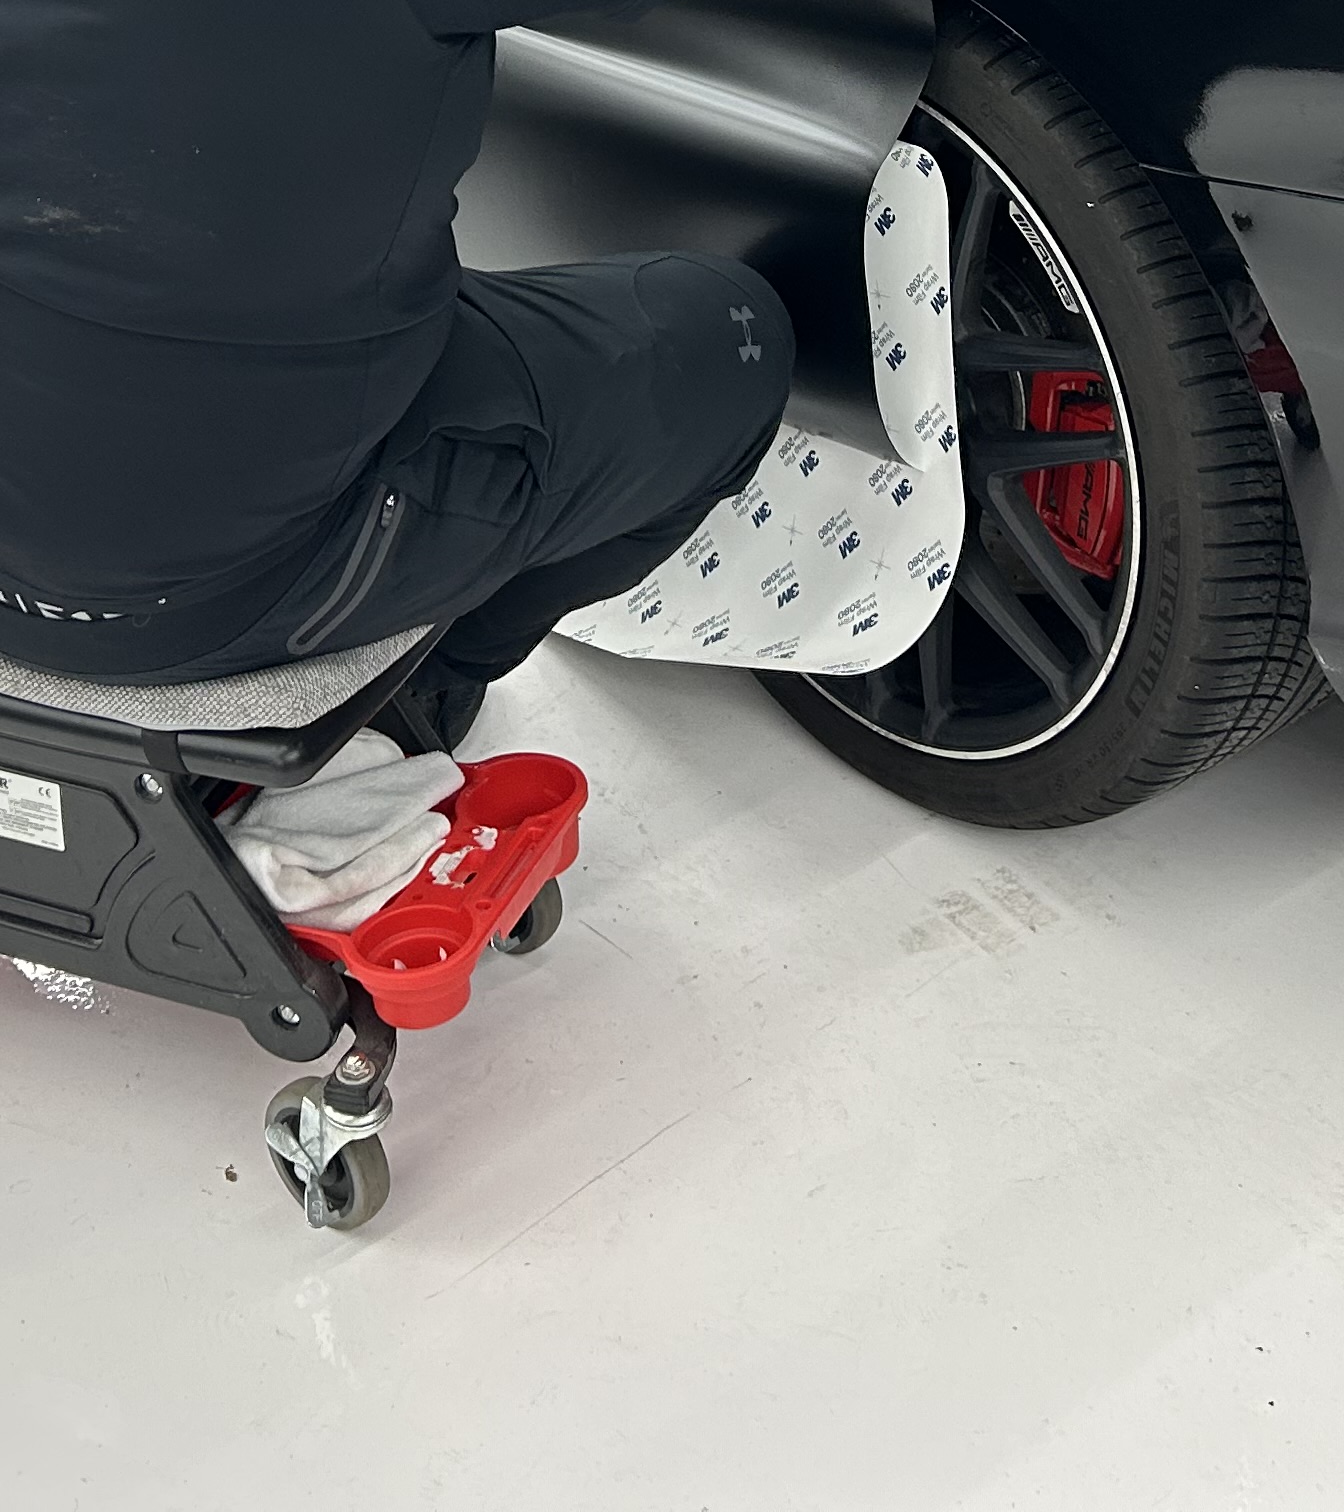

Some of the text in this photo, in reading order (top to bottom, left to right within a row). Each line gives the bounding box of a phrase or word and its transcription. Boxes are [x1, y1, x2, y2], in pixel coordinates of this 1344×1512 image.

[874, 206, 896, 236] 3M
[905, 273, 923, 298] 2080
[1032, 241, 1075, 306] AMG
[930, 286, 949, 316] 3M
[885, 342, 907, 372] 3M
[914, 410, 932, 434] 2080
[938, 424, 956, 453] 3M
[799, 449, 820, 478] 3M
[868, 463, 886, 488] 2080
[891, 478, 913, 507] 3M
[751, 501, 772, 529] 3M
[818, 515, 836, 540] 2080
[838, 531, 861, 560] 3M
[907, 547, 929, 572] 2080
[700, 551, 721, 579] 3M
[927, 562, 952, 592] 3M
[777, 582, 800, 609] 3M
[837, 599, 862, 620] 2080
[641, 599, 662, 624] 3M
[852, 612, 879, 637] 3M
[702, 627, 730, 647] 3M
